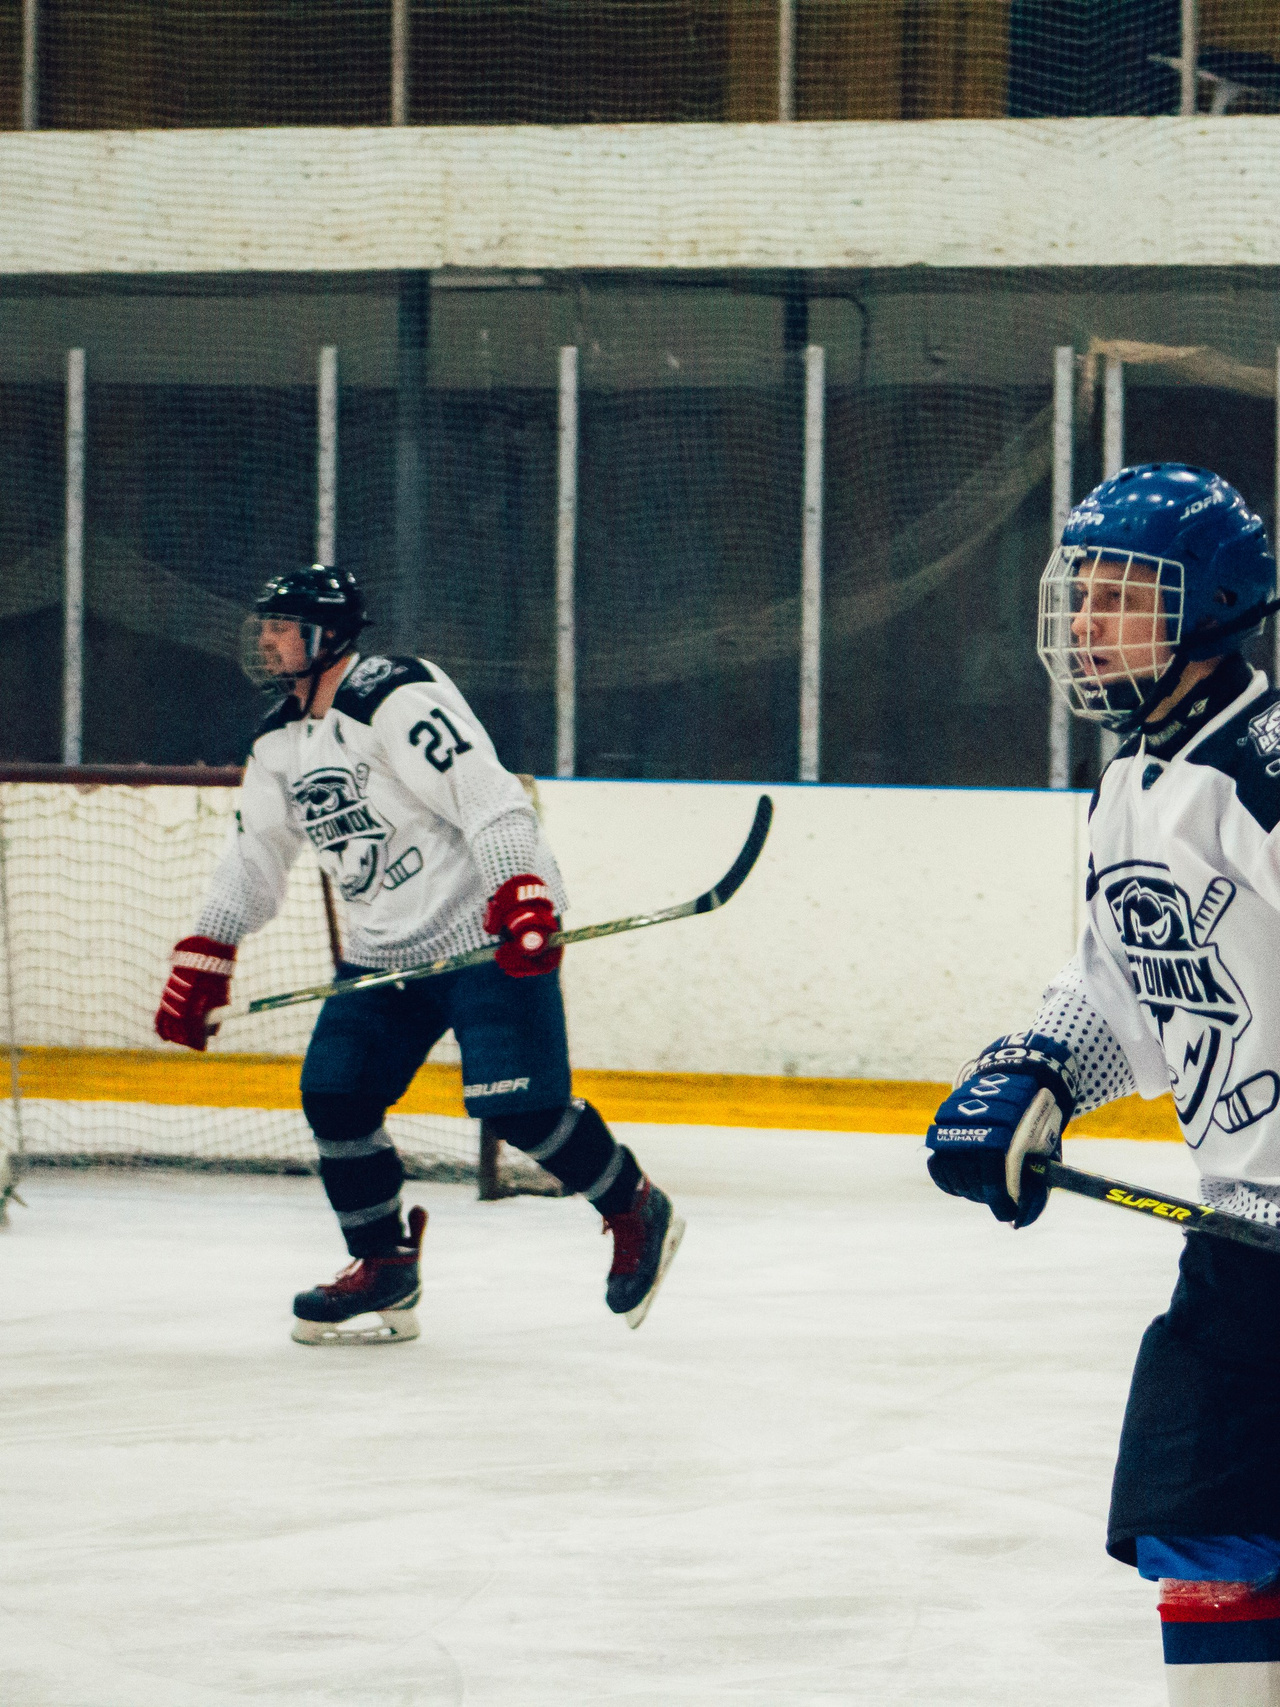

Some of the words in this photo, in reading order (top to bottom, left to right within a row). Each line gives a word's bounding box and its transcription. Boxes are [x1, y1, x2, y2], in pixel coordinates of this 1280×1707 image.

[409, 708, 473, 773] 21
[937, 1128, 988, 1136] KOHO
[1105, 1188, 1192, 1221] SUPER
